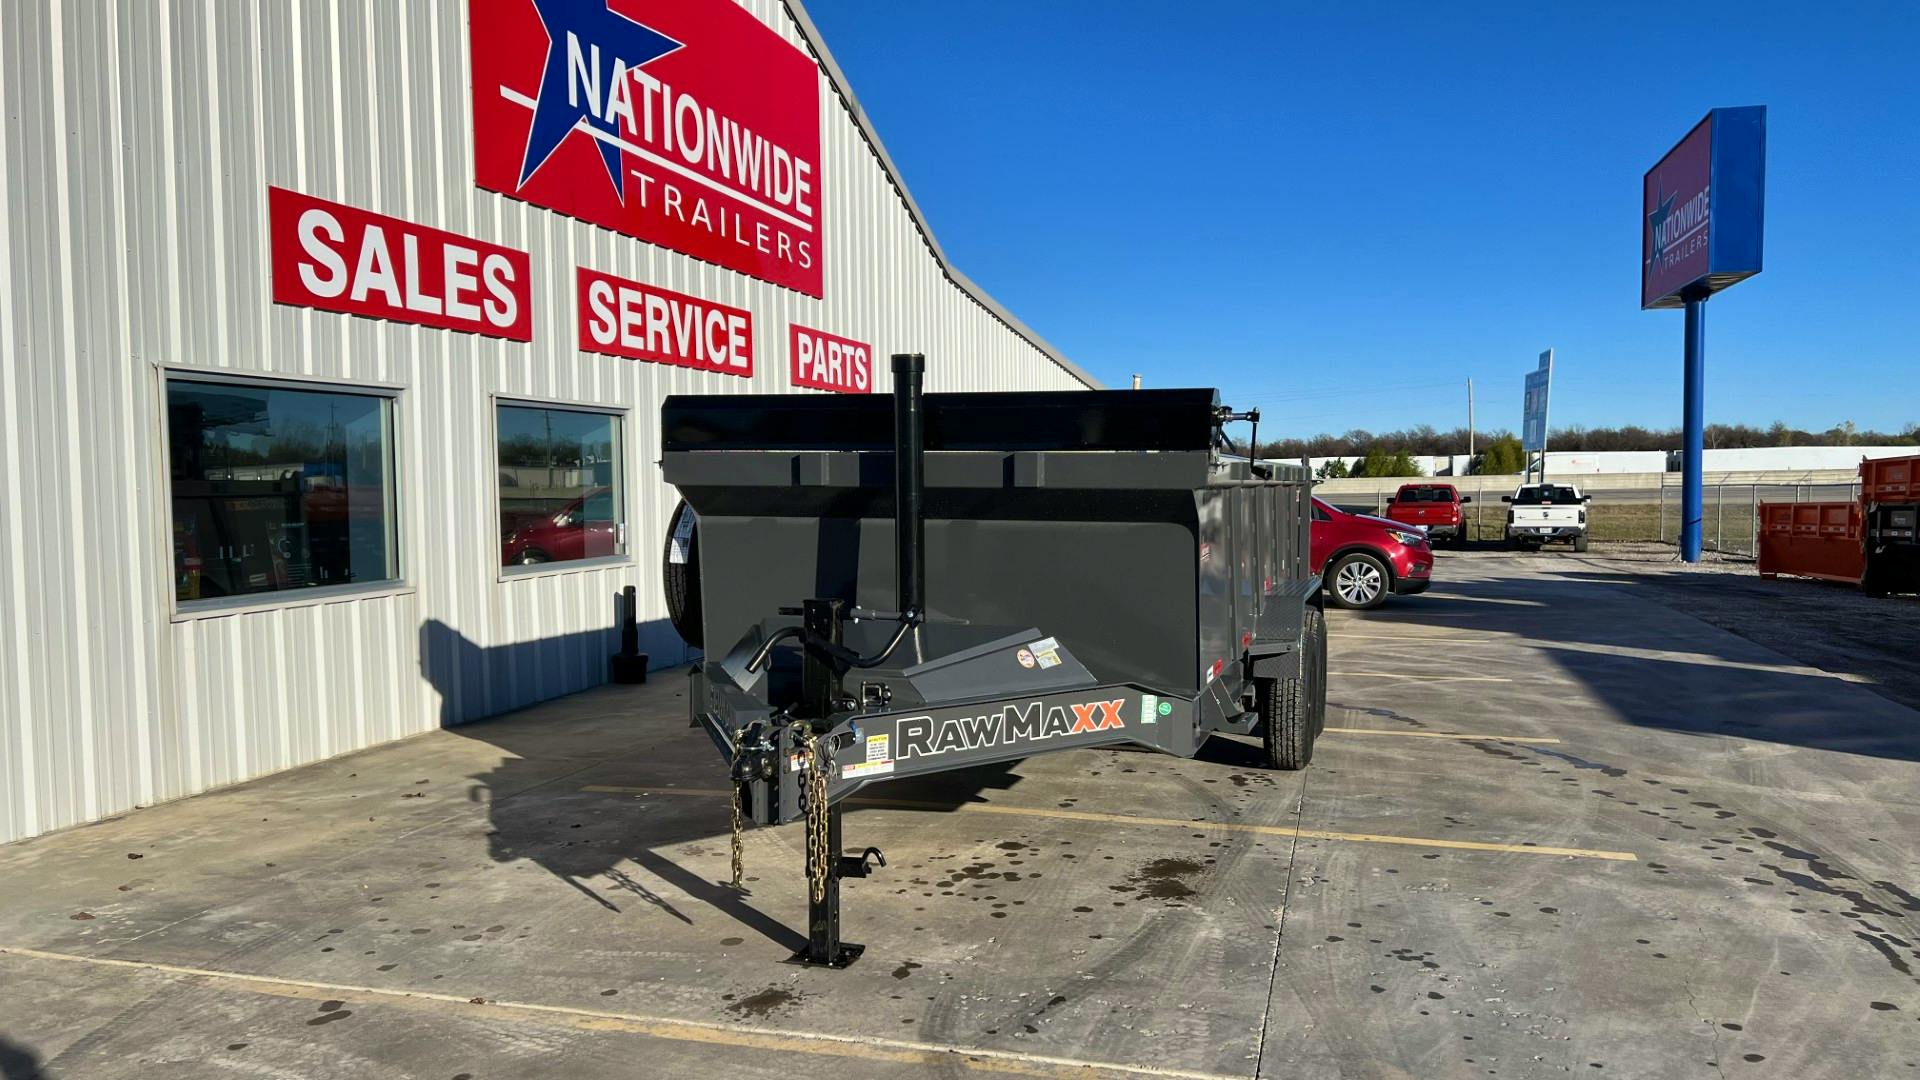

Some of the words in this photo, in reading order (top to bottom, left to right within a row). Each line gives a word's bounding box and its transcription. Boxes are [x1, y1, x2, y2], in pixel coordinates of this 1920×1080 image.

[567, 30, 813, 218] NATIONWIDE
[630, 169, 812, 269] TRAILERS
[1655, 185, 1709, 252] NATIONWIDE
[1664, 230, 1708, 270] TRAILERS
[297, 208, 518, 328] SALES
[588, 279, 748, 368] SERVICE
[797, 332, 868, 391] PARTS
